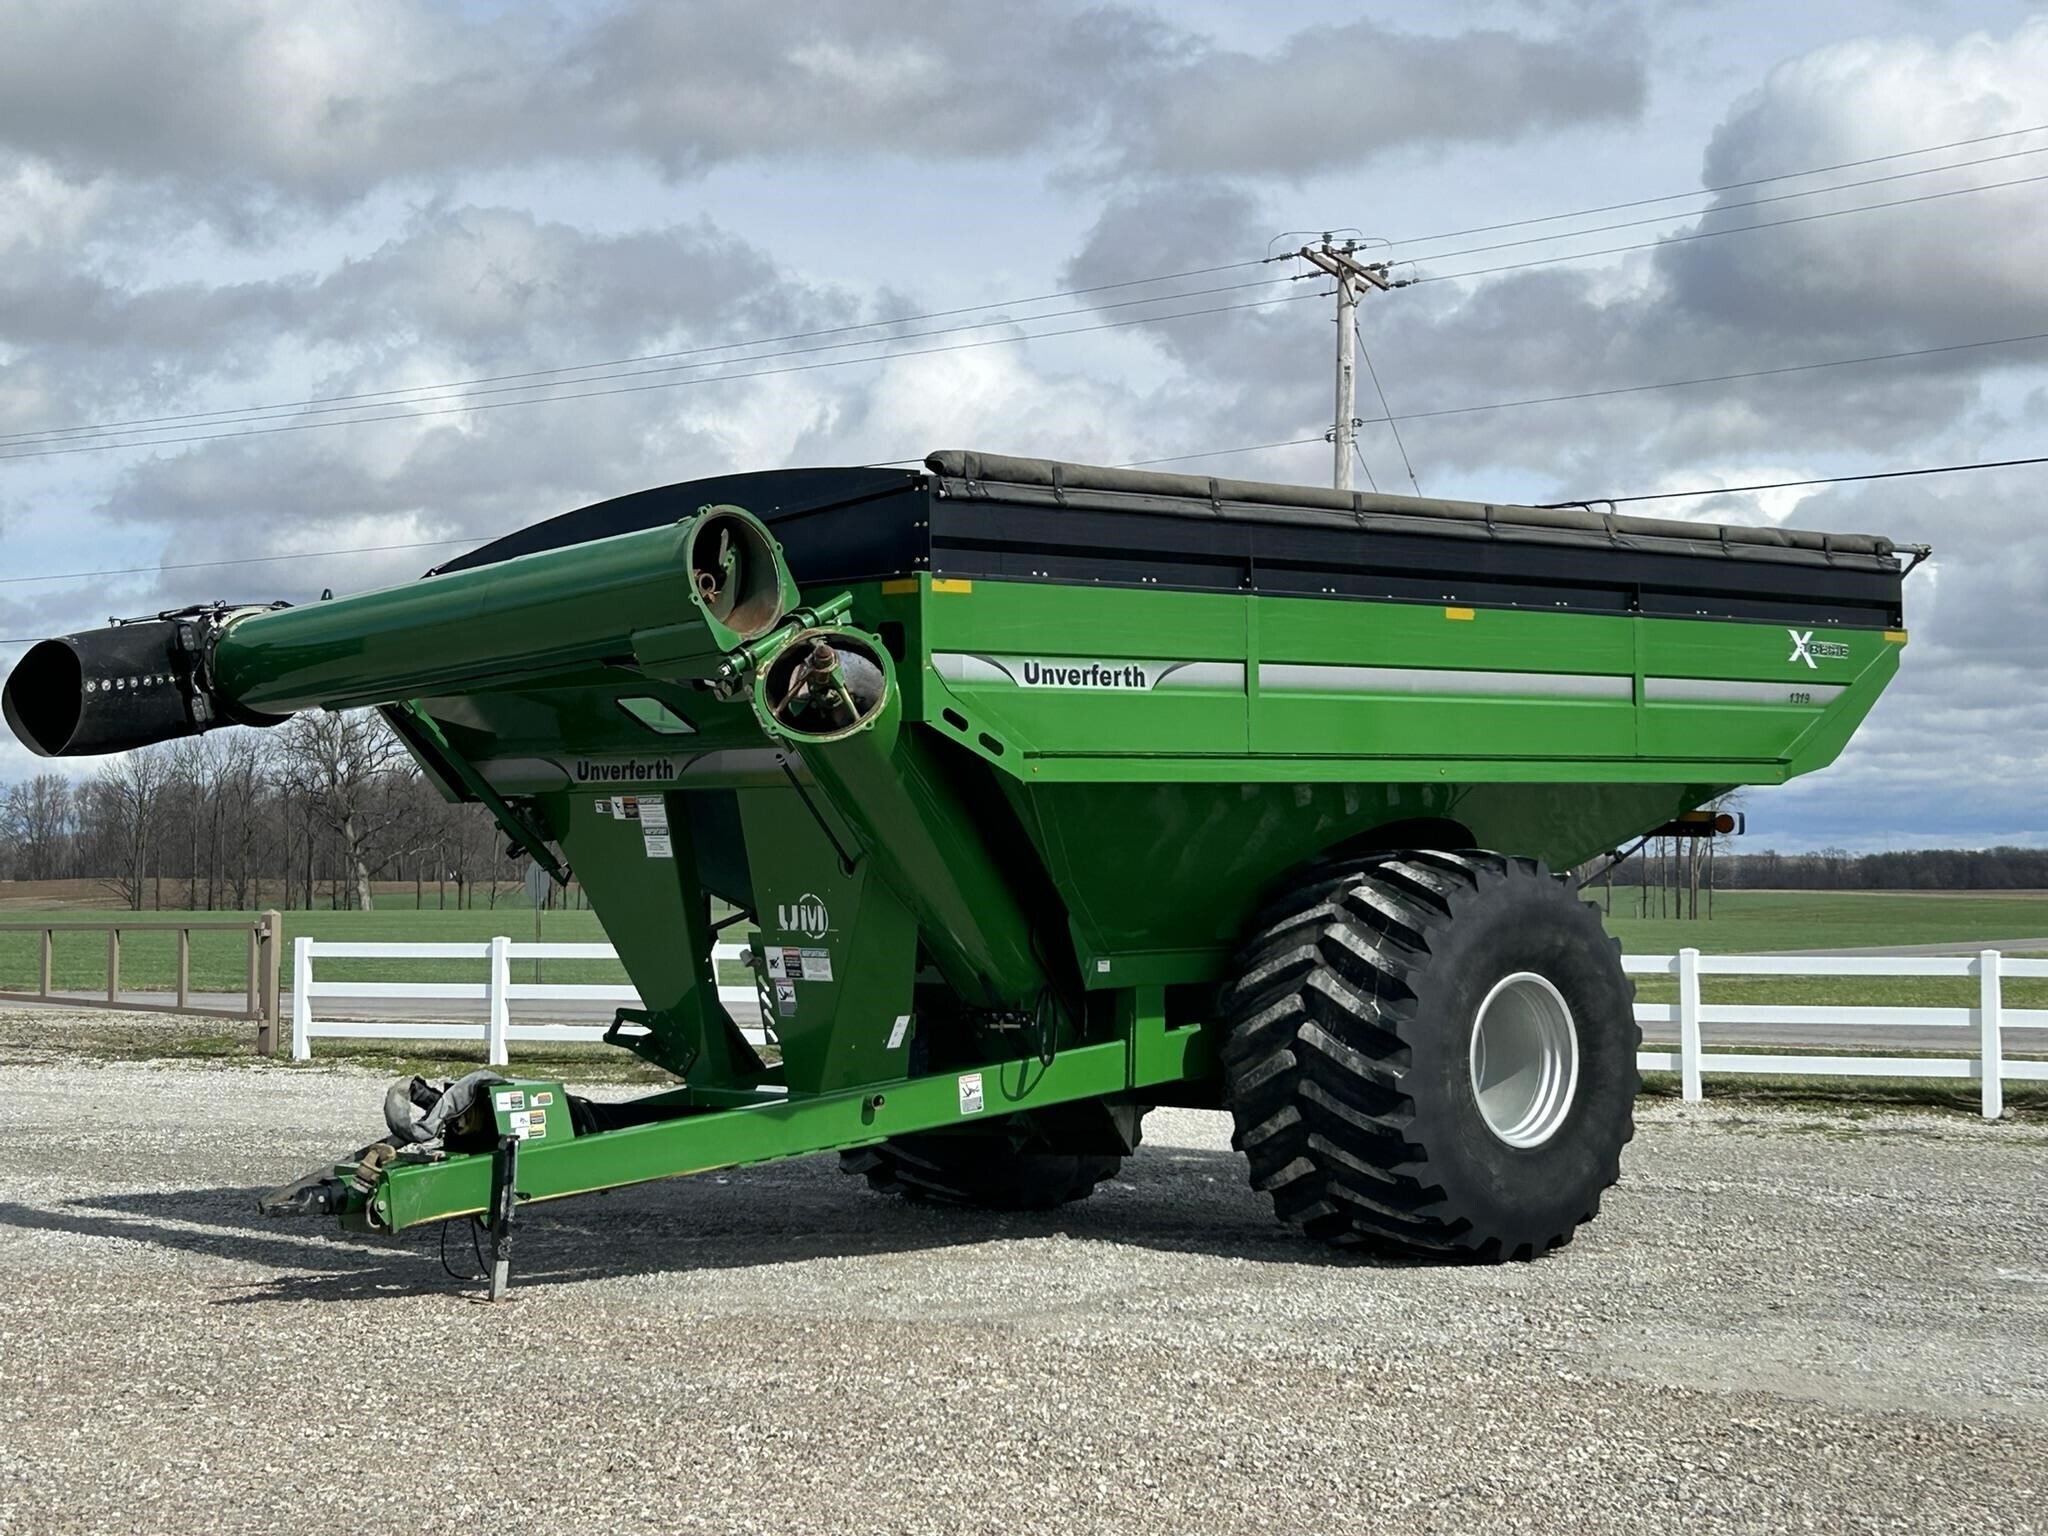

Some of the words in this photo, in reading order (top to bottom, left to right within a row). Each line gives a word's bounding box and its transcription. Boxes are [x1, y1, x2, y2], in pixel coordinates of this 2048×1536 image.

[1024, 662, 1146, 687] Unverferth
[1789, 692, 1811, 704] 1319
[576, 758, 674, 781] Unverferth
